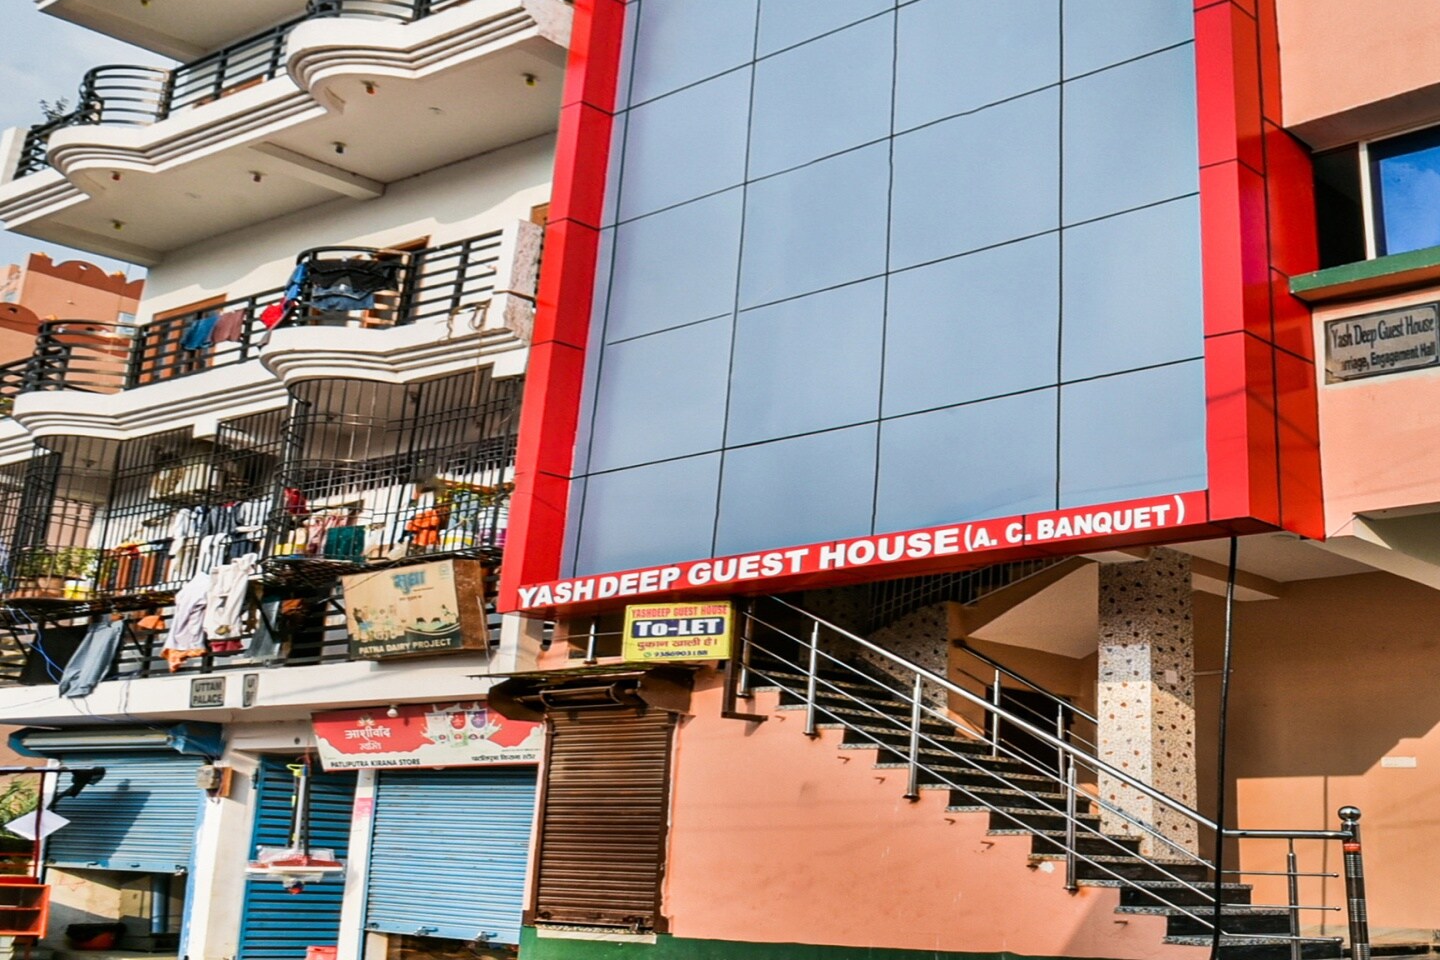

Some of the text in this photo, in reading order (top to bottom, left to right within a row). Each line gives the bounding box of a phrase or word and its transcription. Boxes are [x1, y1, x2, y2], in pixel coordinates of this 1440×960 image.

[1331, 314, 1434, 349] Yash Deep Guest House
[517, 578, 595, 610] YASH
[598, 566, 680, 598] DEEP
[687, 548, 809, 586] GUEST
[818, 527, 960, 570] HOUSE
[673, 606, 698, 617] GUEST
[700, 604, 728, 615] HOUSE
[413, 638, 452, 649] PROJECT
[193, 694, 223, 705] PALACE
[371, 759, 397, 767] KIRANA
